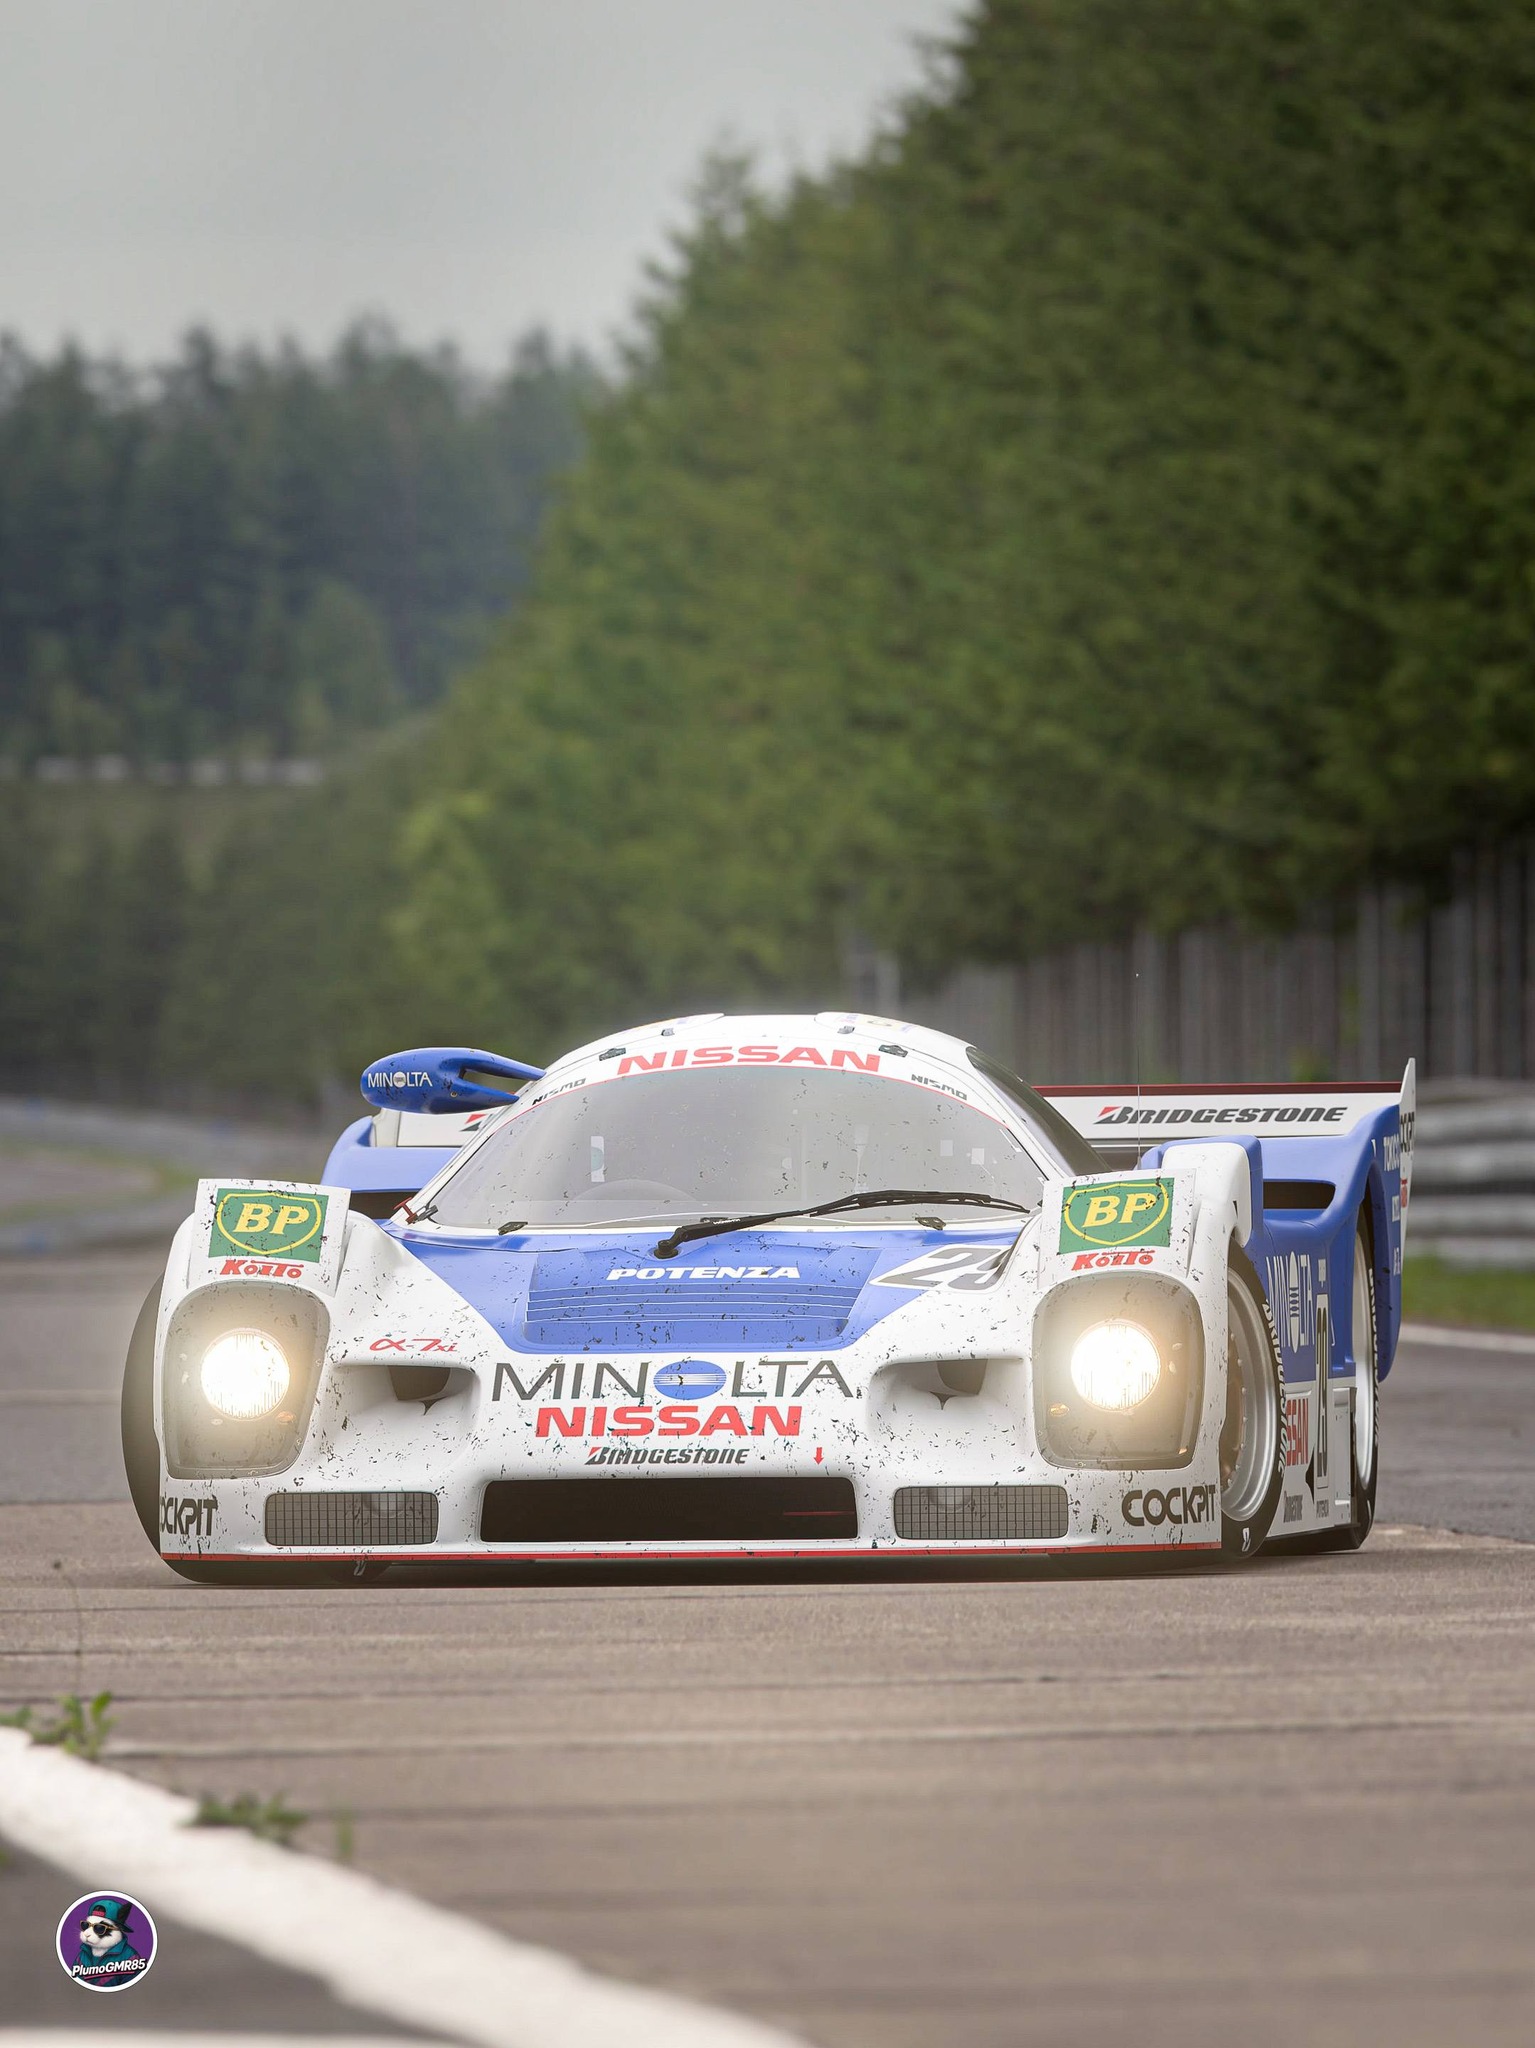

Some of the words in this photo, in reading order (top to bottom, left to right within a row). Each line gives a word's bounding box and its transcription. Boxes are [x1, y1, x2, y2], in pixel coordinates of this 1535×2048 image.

[616, 1045, 881, 1076] NISSAN
[367, 1071, 433, 1089] MINOLTA
[532, 1078, 587, 1105] NISMO
[911, 1073, 968, 1100] NISMO
[1093, 1105, 1348, 1125] BRIDGESTONE
[232, 1202, 310, 1235] BP
[1082, 1192, 1158, 1228] BP
[605, 1266, 801, 1282] POTENZA
[491, 1359, 854, 1402] MINOLTA
[535, 1405, 803, 1438] NISSAN
[583, 1446, 750, 1466] BRIDGESTONE
[1121, 1484, 1217, 1527] COCKPIT
